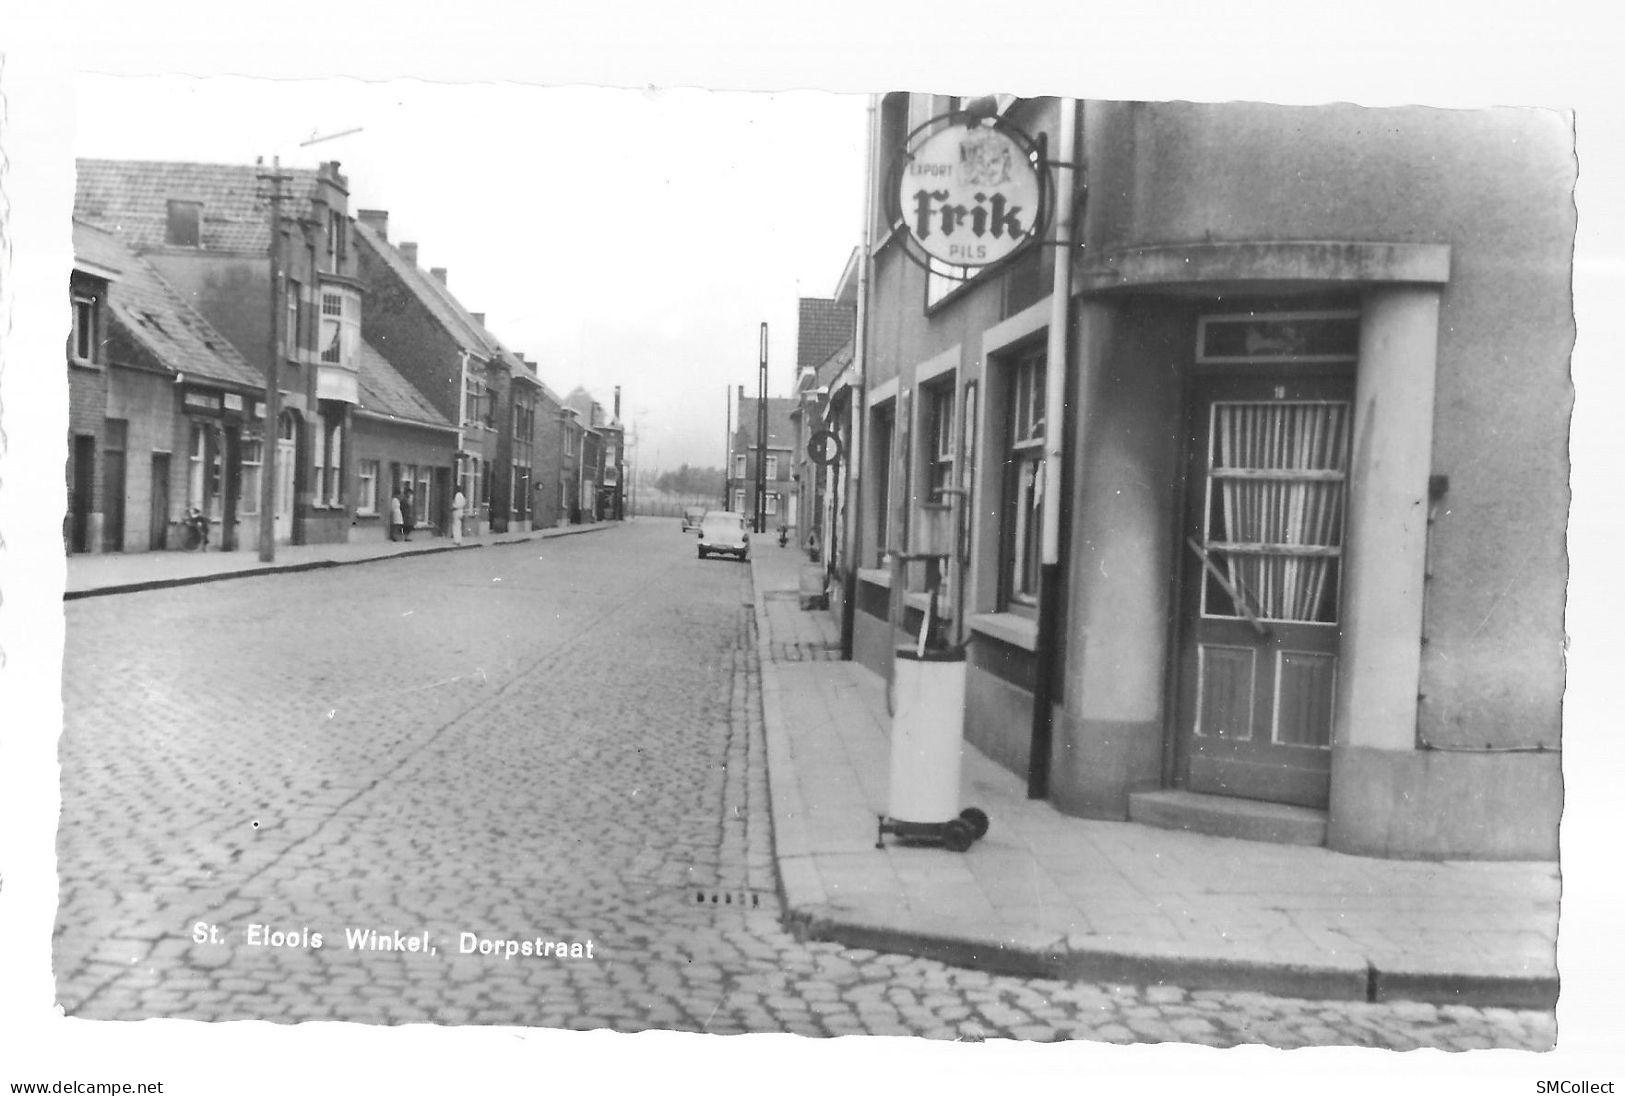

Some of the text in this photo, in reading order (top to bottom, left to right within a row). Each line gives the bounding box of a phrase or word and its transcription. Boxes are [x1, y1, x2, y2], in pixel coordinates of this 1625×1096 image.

[910, 163, 953, 177] EXPORT
[913, 189, 1026, 241] Frik
[949, 244, 987, 259] PILS
